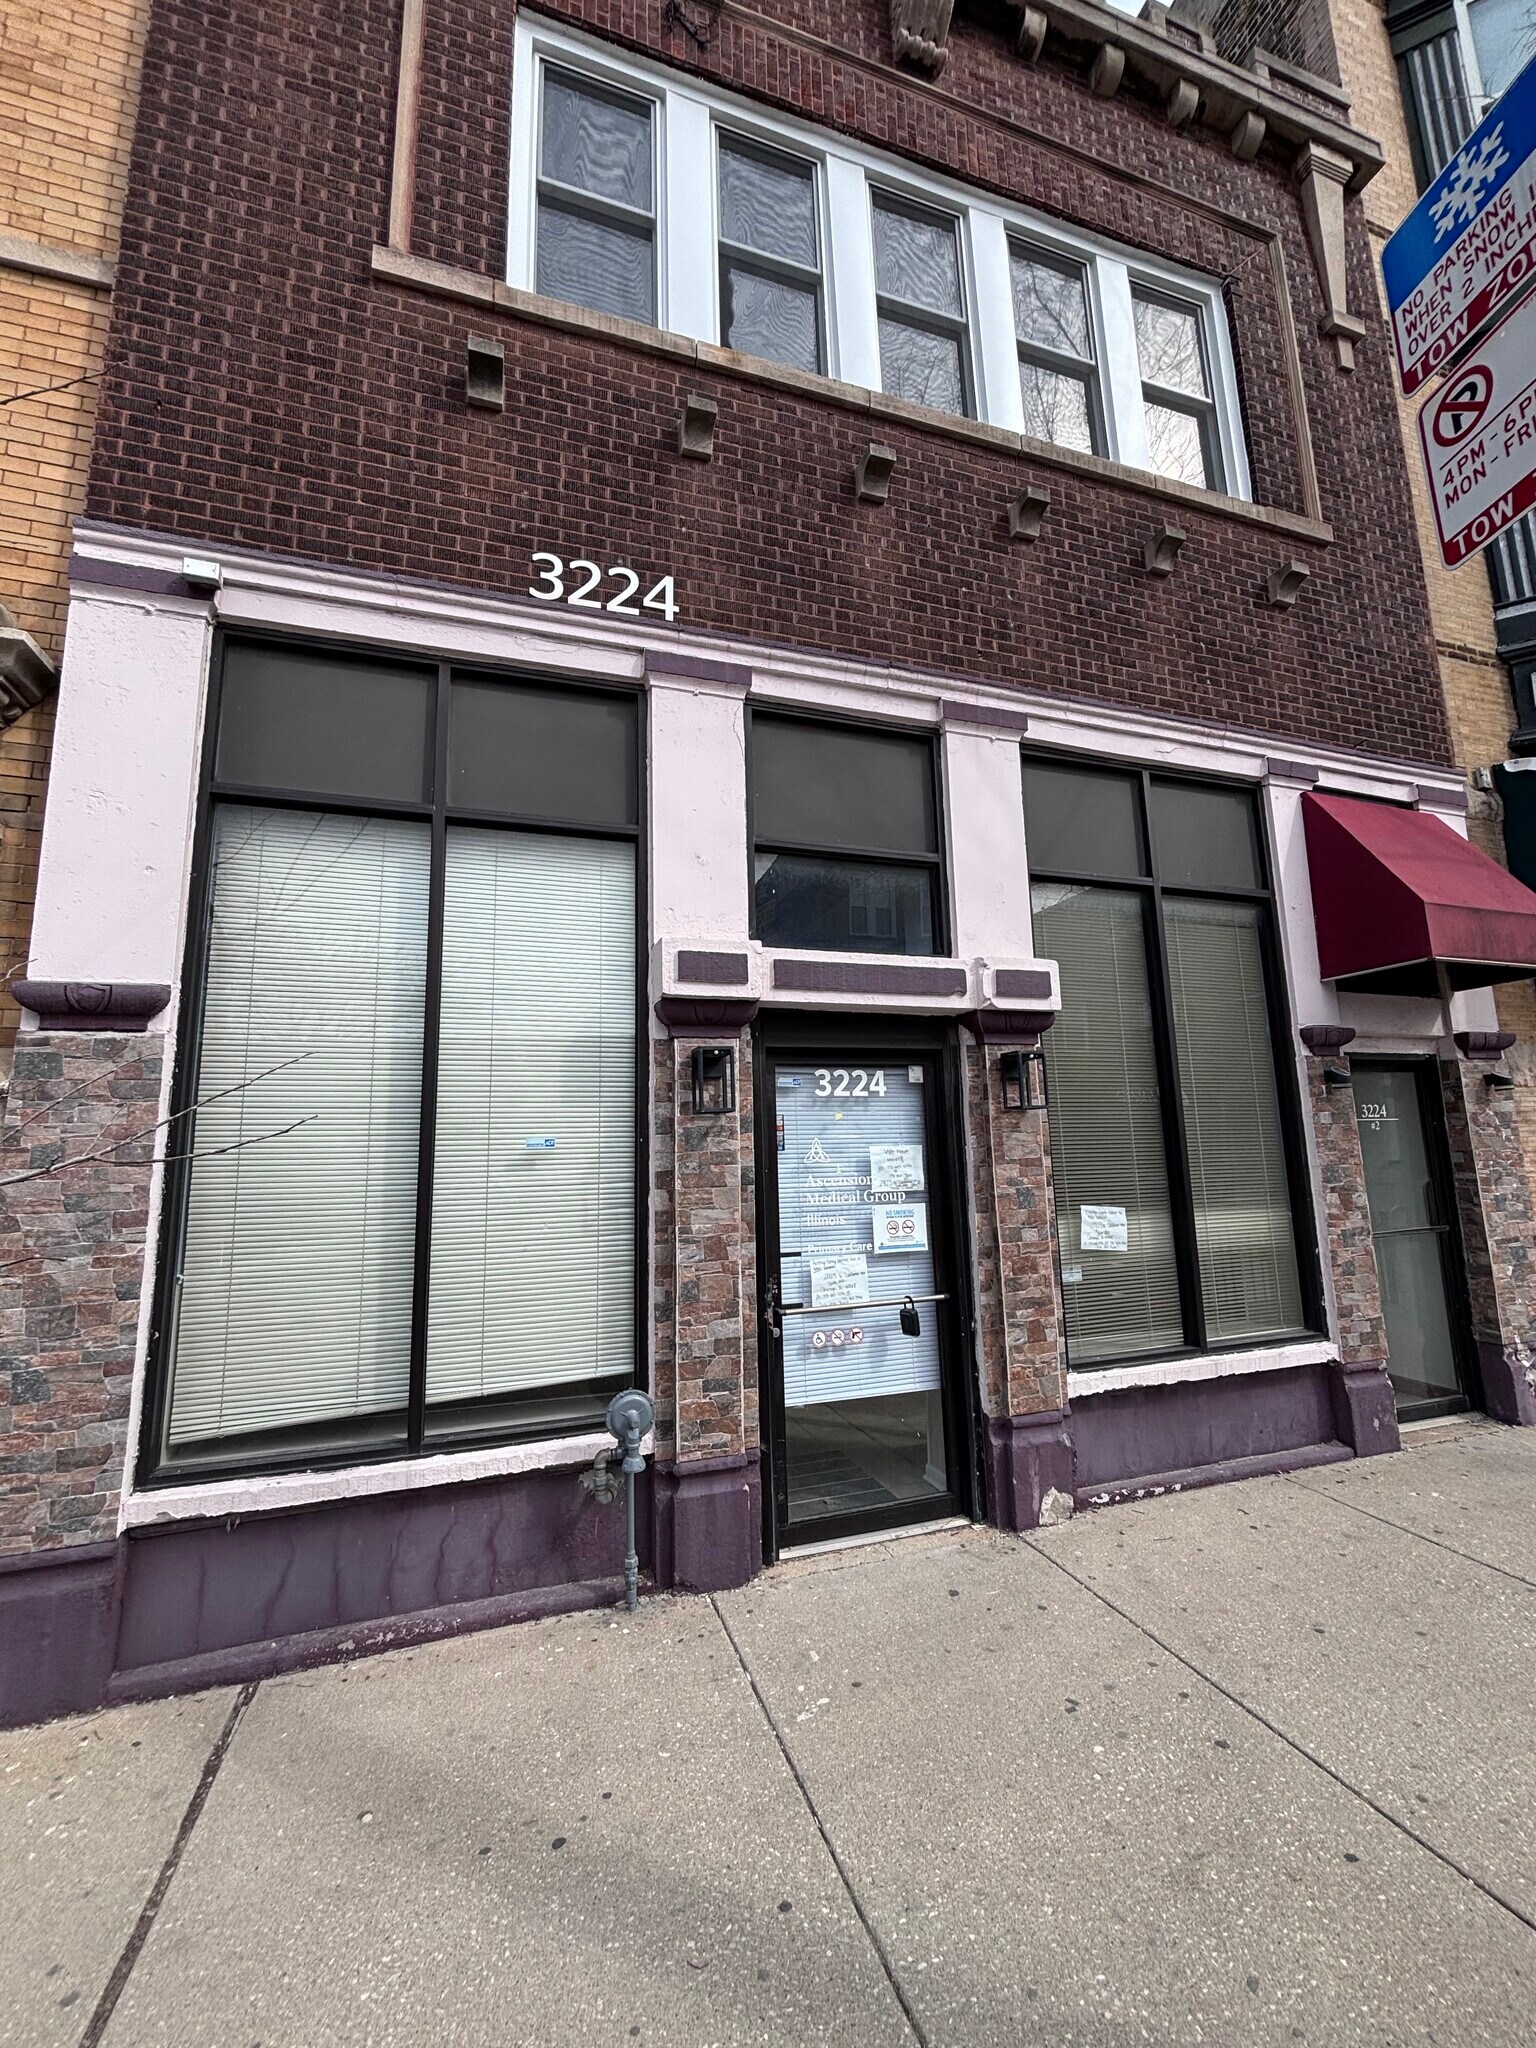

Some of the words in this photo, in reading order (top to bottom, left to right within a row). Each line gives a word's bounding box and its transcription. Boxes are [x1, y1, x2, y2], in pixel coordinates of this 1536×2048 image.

[1402, 289, 1424, 323] NO
[1433, 187, 1512, 287] PARKING
[1405, 277, 1453, 339] WHEN
[1462, 203, 1516, 275] SNOW
[1408, 301, 1452, 356] OVER
[1461, 276, 1475, 300] 2
[1411, 309, 1469, 381] TOW
[1442, 438, 1486, 487] 4PM
[1503, 388, 1536, 433] 6P
[1444, 461, 1487, 510] MON
[1452, 491, 1515, 555] TOW
[528, 551, 680, 622] 3224
[814, 1069, 887, 1097] 3224
[1361, 1104, 1387, 1118] 3224
[1371, 1121, 1380, 1130] #2
[806, 1173, 876, 1187] Ascension
[806, 1190, 860, 1204] Medical
[863, 1189, 906, 1204] Group
[806, 1212, 846, 1227] Illinois
[849, 1241, 873, 1251] Care
